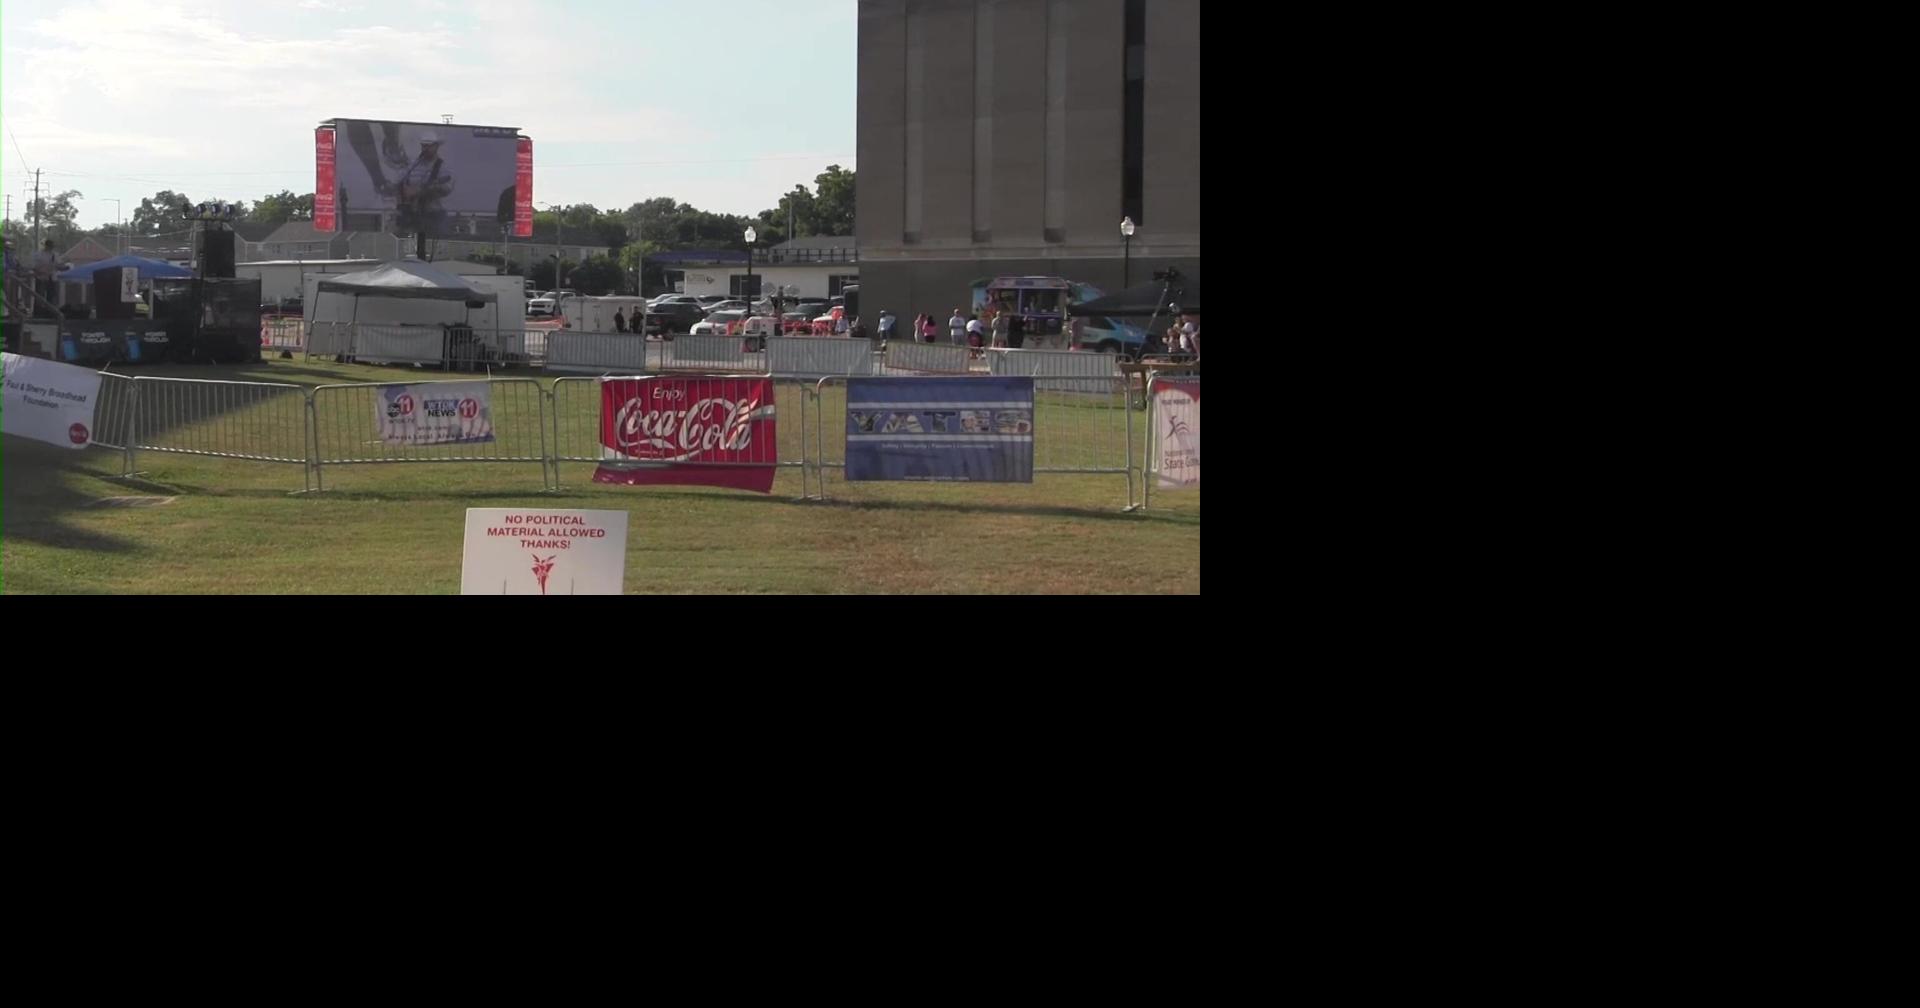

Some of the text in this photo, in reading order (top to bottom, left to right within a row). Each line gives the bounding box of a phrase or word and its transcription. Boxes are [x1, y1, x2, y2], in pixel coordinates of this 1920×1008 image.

[25, 383, 48, 398] Sherry
[48, 387, 87, 403] Broadhead
[652, 386, 686, 401] Enjoy
[23, 395, 60, 409] Foundation
[398, 397, 411, 414] 11
[460, 401, 476, 417] 11
[427, 409, 457, 417] NEWS
[616, 396, 752, 451] Coca-Cola
[850, 409, 1032, 434] YATES
[1163, 457, 1185, 470] State
[505, 515, 586, 526] NO POLITICAL
[487, 527, 606, 538] MATERIAL ALLOWED
[520, 540, 571, 549] THANKS!
